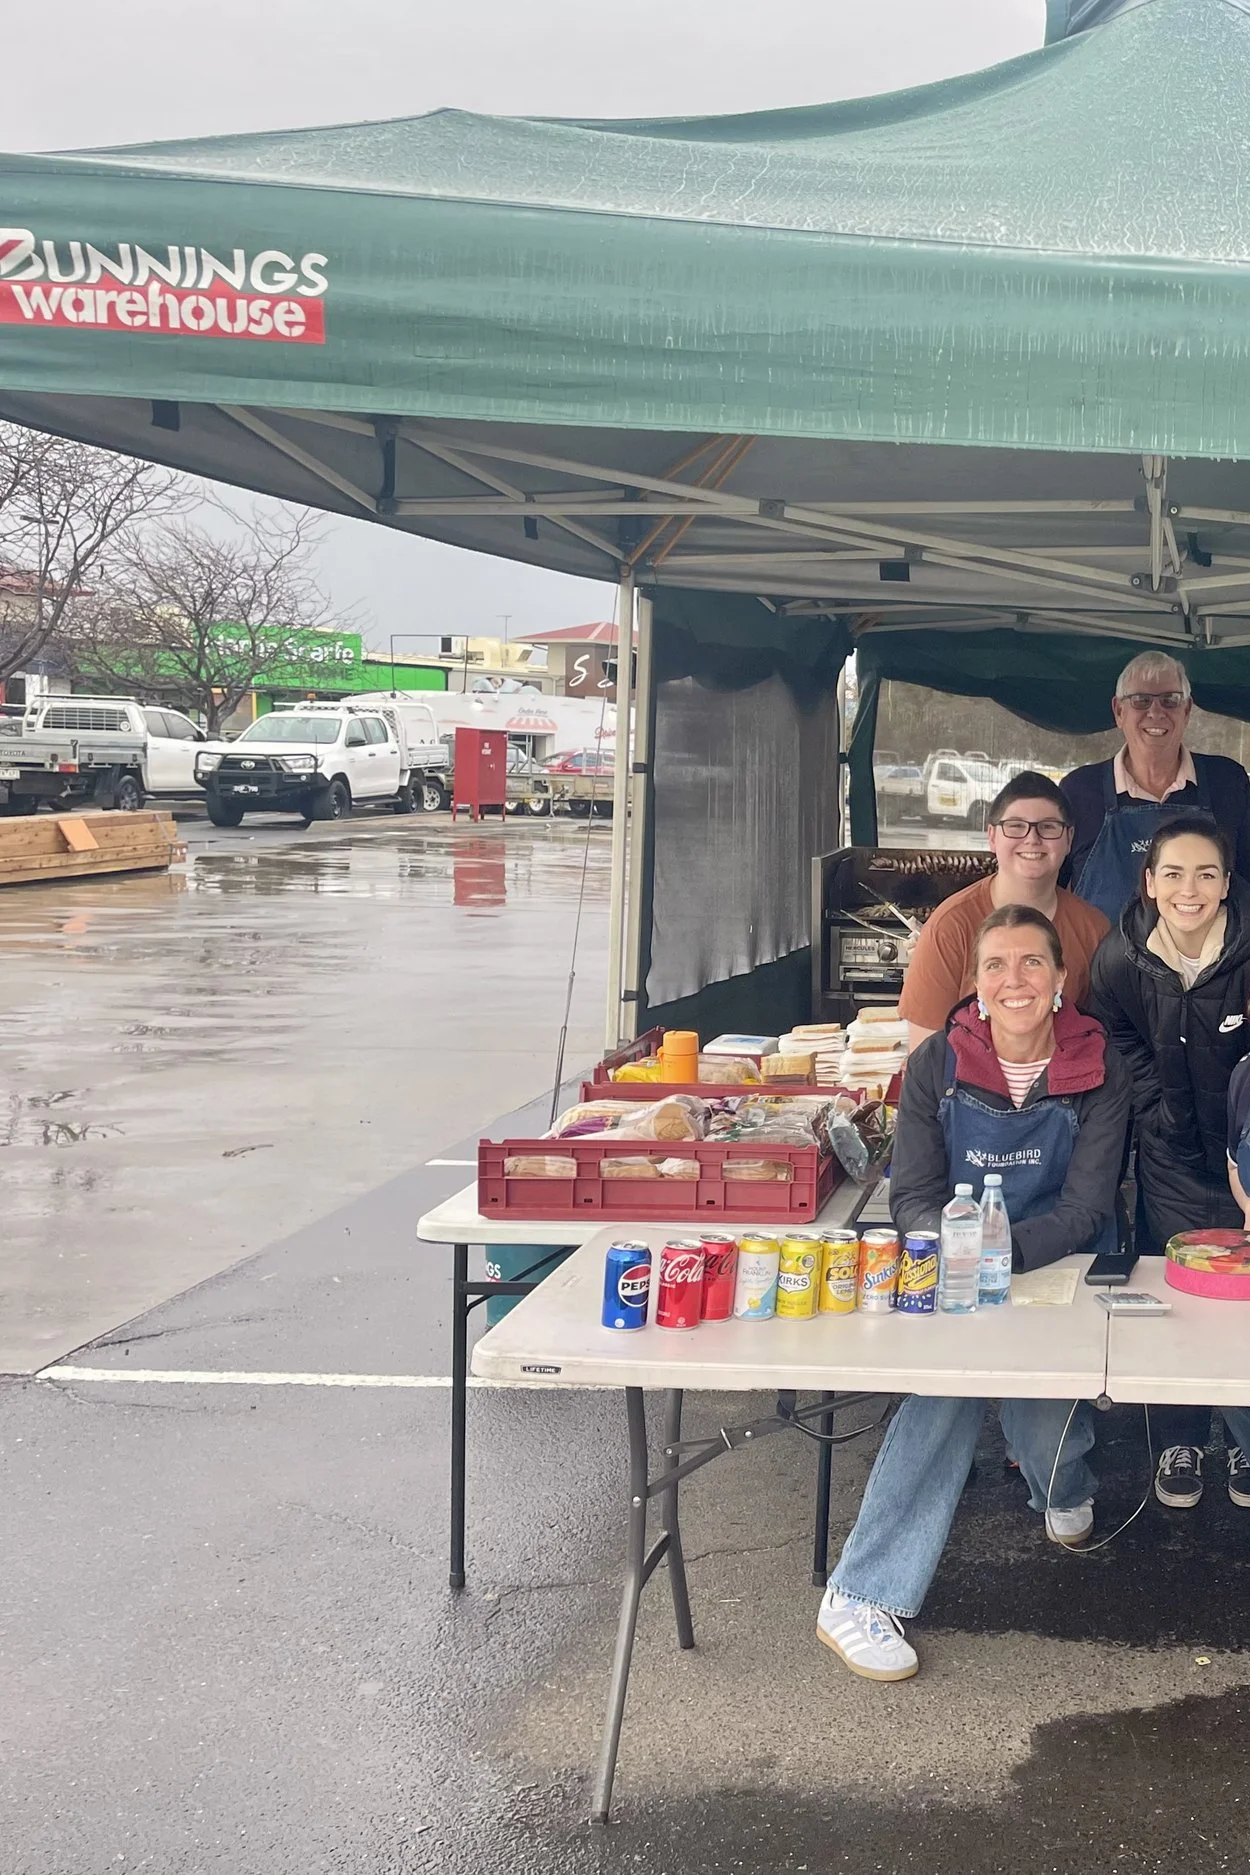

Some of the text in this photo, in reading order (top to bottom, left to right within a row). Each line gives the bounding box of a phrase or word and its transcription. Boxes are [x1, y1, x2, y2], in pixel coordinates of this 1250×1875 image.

[0, 228, 329, 297] BUNNINGS
[12, 280, 307, 337] warehouse
[988, 1149, 1041, 1162] BLUEBIRD
[778, 1275, 808, 1287] KIRKS
[830, 1266, 858, 1281] SOL
[863, 1257, 898, 1290] Sunkis
[898, 1250, 938, 1295] Passiona
[621, 1280, 650, 1291] PEPS
